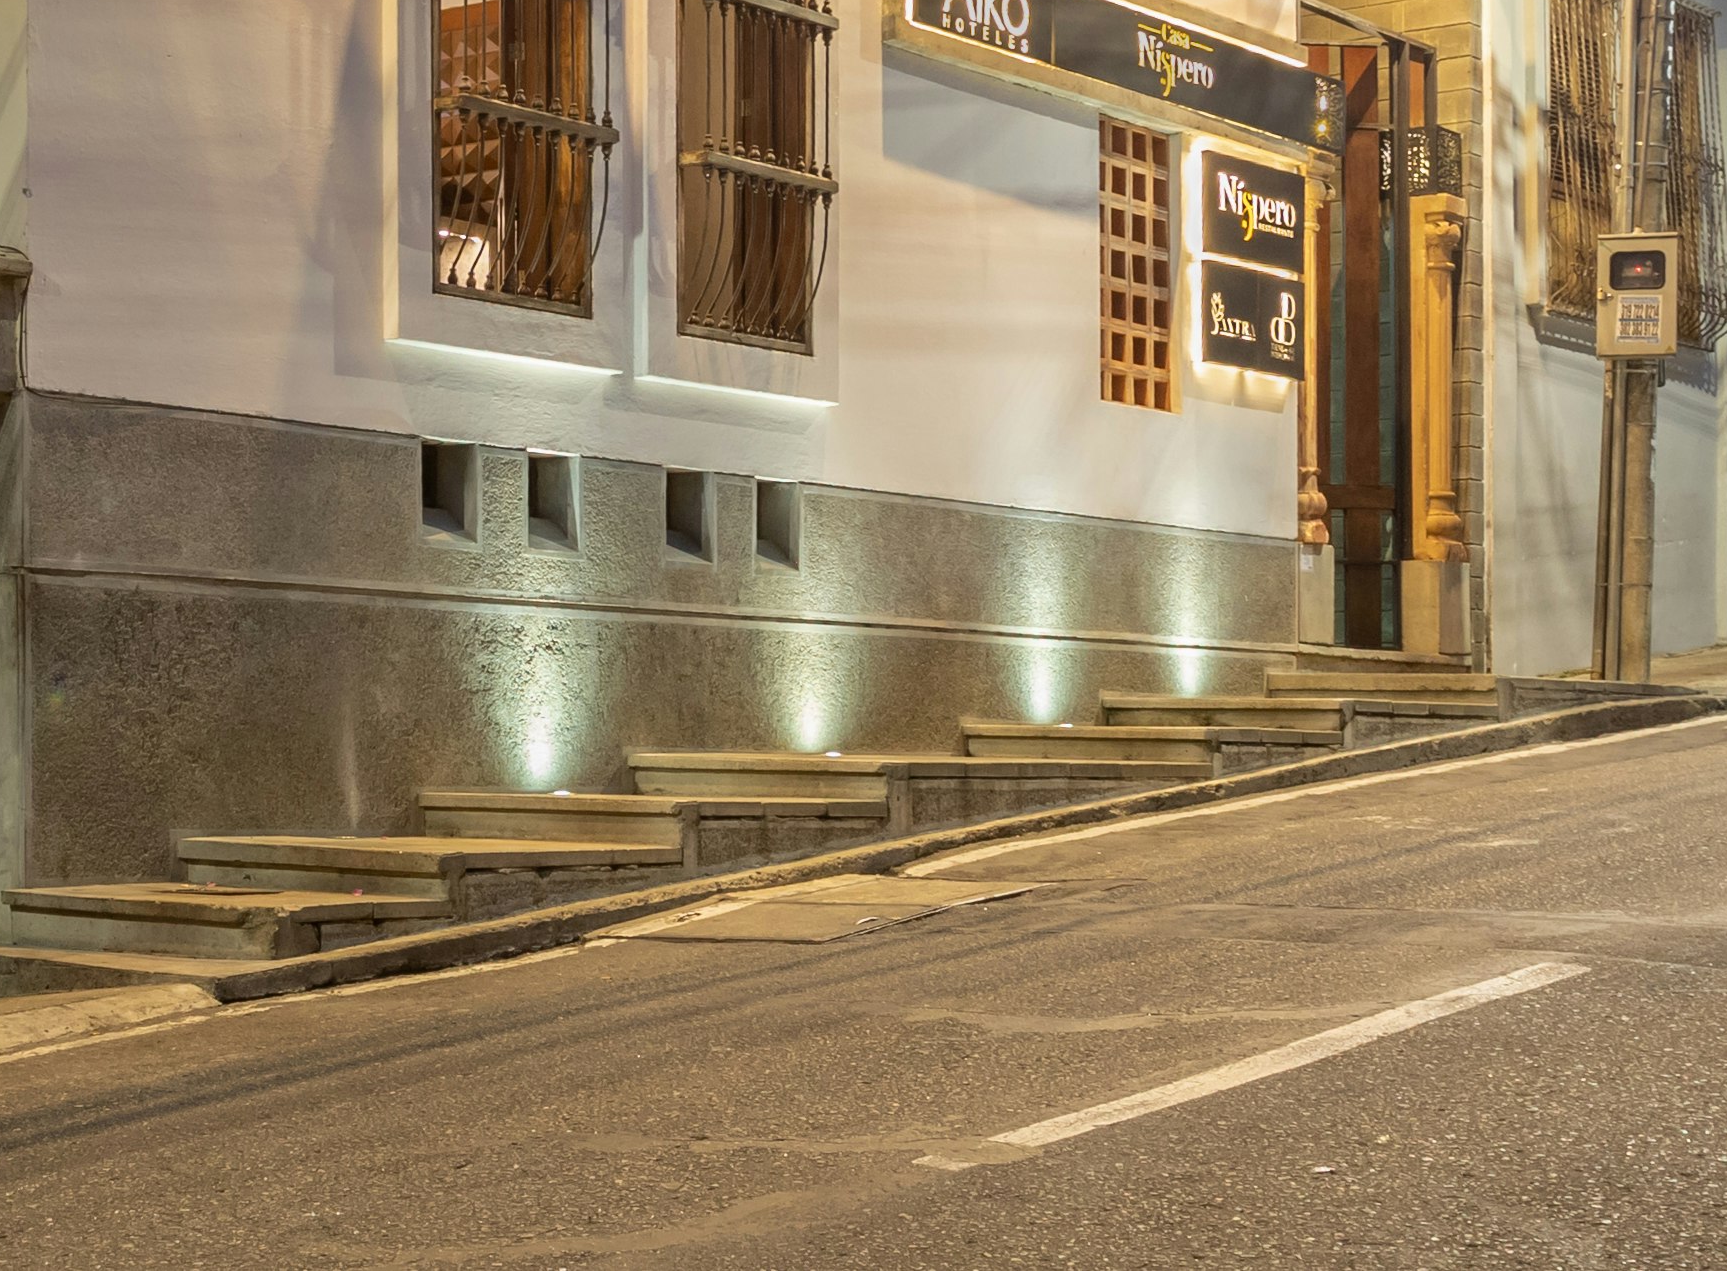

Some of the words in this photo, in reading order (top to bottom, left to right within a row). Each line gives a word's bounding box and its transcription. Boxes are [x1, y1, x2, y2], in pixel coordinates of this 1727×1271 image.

[942, 13, 1029, 54] HOTELES
[1137, 31, 1214, 97] Níspero
[1217, 171, 1297, 242] Níspero
